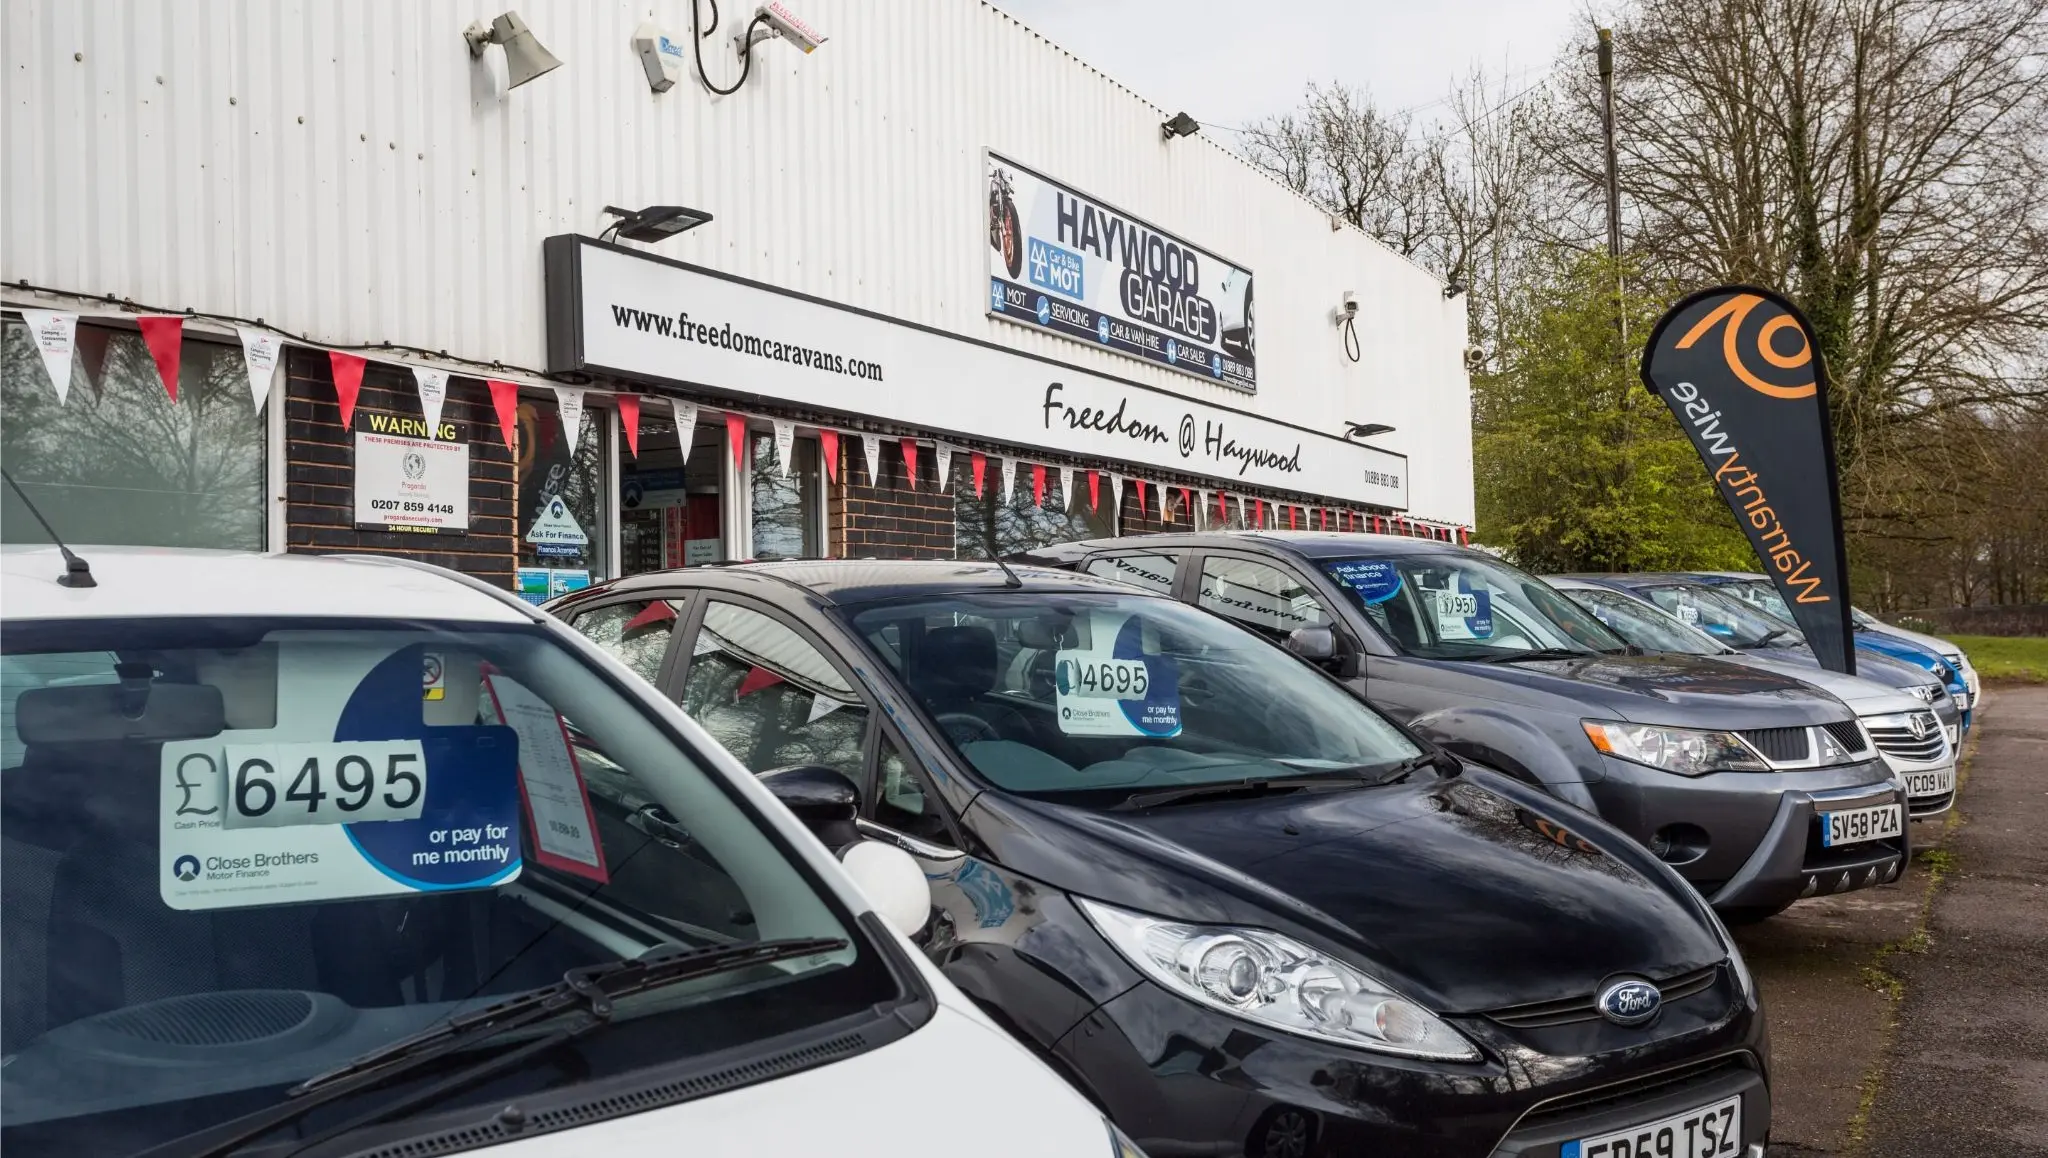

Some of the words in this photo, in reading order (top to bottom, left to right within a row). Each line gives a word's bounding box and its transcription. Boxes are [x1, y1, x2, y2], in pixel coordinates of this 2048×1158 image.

[1057, 191, 1198, 293] HAYWOOD
[1050, 263, 1080, 293] MOT
[1007, 288, 1027, 306] MOT
[1127, 274, 1210, 341] GARAGE
[1052, 303, 1089, 327] SERVICING
[611, 303, 883, 382] www.freedomcaravans.com
[1110, 322, 1124, 338] CAR
[1124, 328, 1130, 340] &
[1131, 329, 1144, 344] VAN
[1145, 334, 1160, 349] HIRE
[1177, 344, 1190, 359] CAR
[1190, 348, 1206, 364] SALES
[369, 414, 456, 440] WARNNG
[1043, 382, 1169, 444] Freedom
[1179, 413, 1196, 458] @
[1205, 421, 1302, 476] Haywood
[384, 438, 411, 446] PREMISES
[423, 442, 453, 451] PROTECTED
[372, 499, 400, 510] 0207
[404, 502, 424, 512] 859
[428, 504, 454, 514] 4148
[531, 530, 543, 538] Ask
[545, 531, 556, 539] For
[558, 532, 584, 540] Finance
[1343, 572, 1383, 580] finance
[1358, 563, 1389, 571] about
[1153, 715, 1178, 726] monthly
[1155, 706, 1167, 715] pay
[1168, 706, 1177, 714] for
[1905, 774, 1935, 793] YC09
[198, 820, 221, 828] Price
[1832, 812, 1869, 840] SV58
[1871, 808, 1898, 835] PZA
[430, 829, 447, 844] or
[452, 827, 481, 848] pay
[485, 823, 509, 841] for
[206, 856, 250, 871] Close
[254, 851, 319, 867] Brothers
[412, 850, 440, 865] me
[444, 843, 510, 866] monthly
[207, 870, 233, 880] Motor
[236, 869, 270, 879] Finance
[1618, 988, 1652, 1013] Ford
[1684, 1105, 1735, 1158] TSZ
